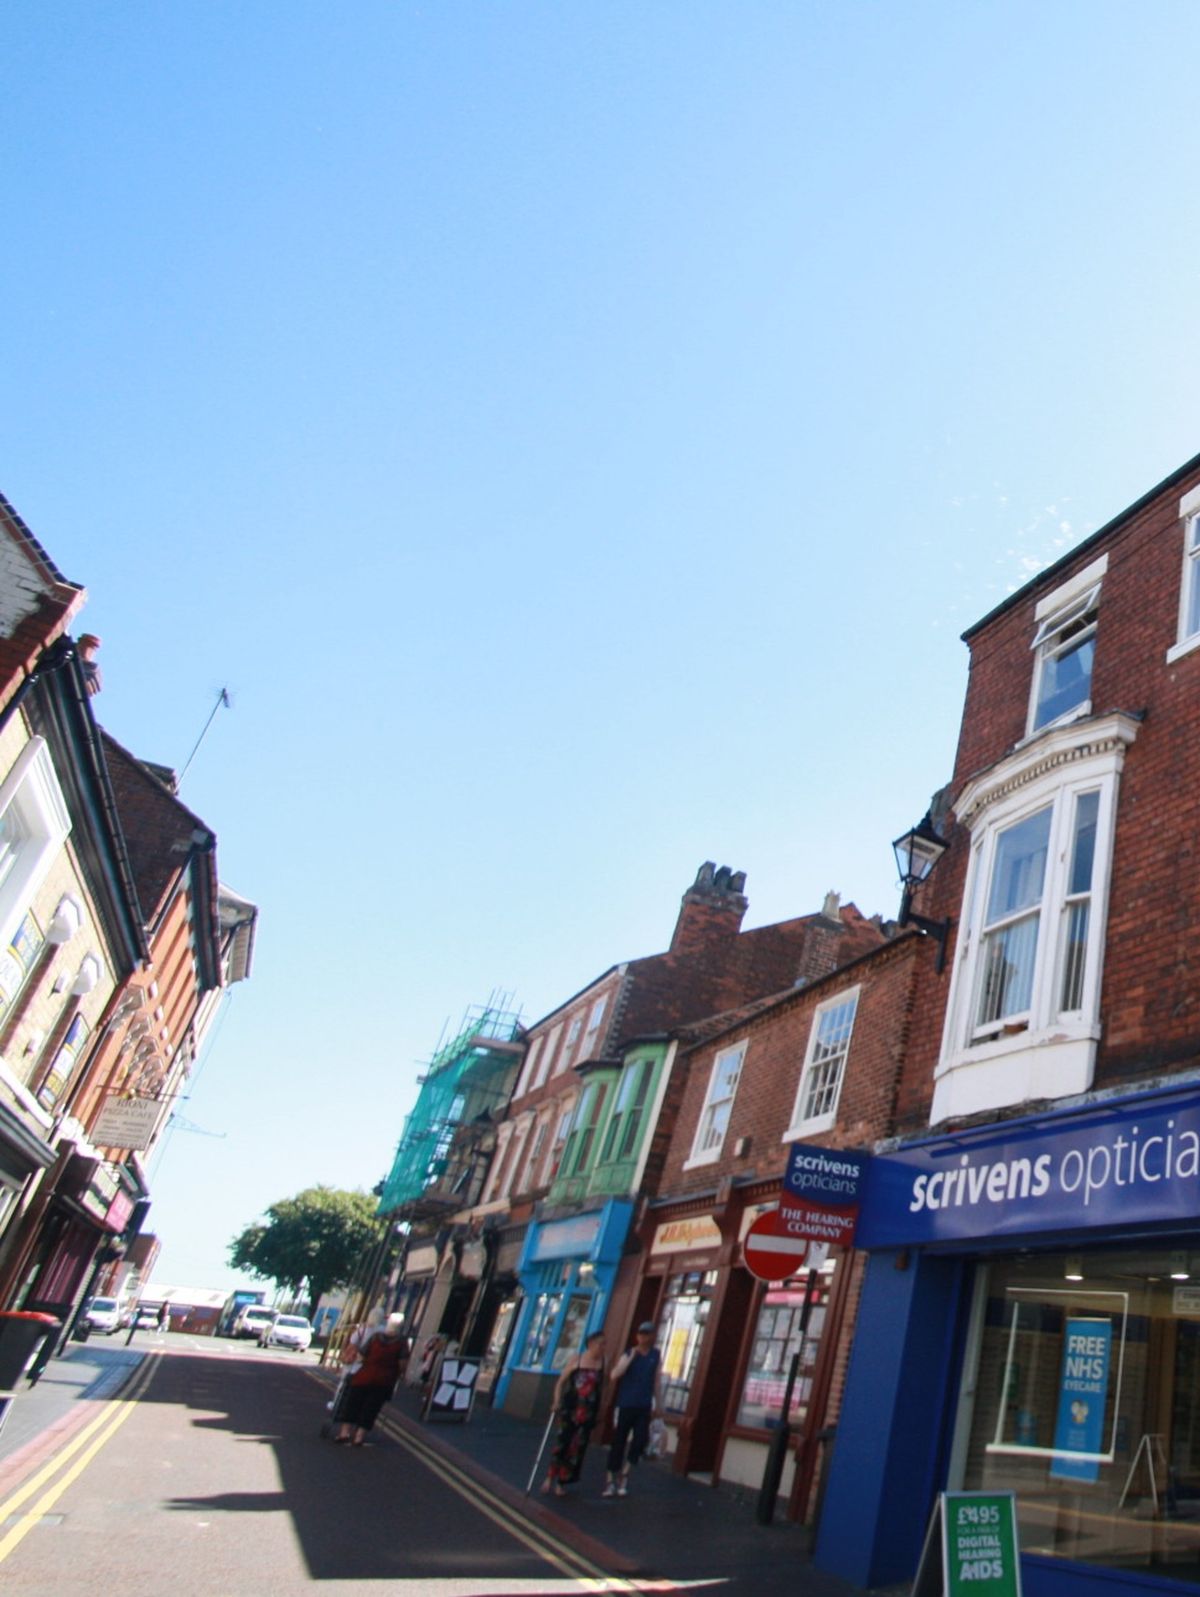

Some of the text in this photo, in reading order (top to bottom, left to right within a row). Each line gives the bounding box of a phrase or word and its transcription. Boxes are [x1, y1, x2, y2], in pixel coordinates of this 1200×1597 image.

[791, 1154, 861, 1195] scrivens opticians
[909, 1153, 1052, 1213] scrivens
[781, 1207, 855, 1229] THE HEARING
[786, 1220, 843, 1239] COMPANY
[1067, 1335, 1106, 1356] FREE
[1065, 1357, 1104, 1380] NHS
[1063, 1380, 1102, 1393] EYECARE
[957, 1506, 1000, 1525] £495
[957, 1535, 1001, 1549] DIGITAL
[957, 1548, 1003, 1560] HEARING
[958, 1561, 1004, 1581] AIDS
